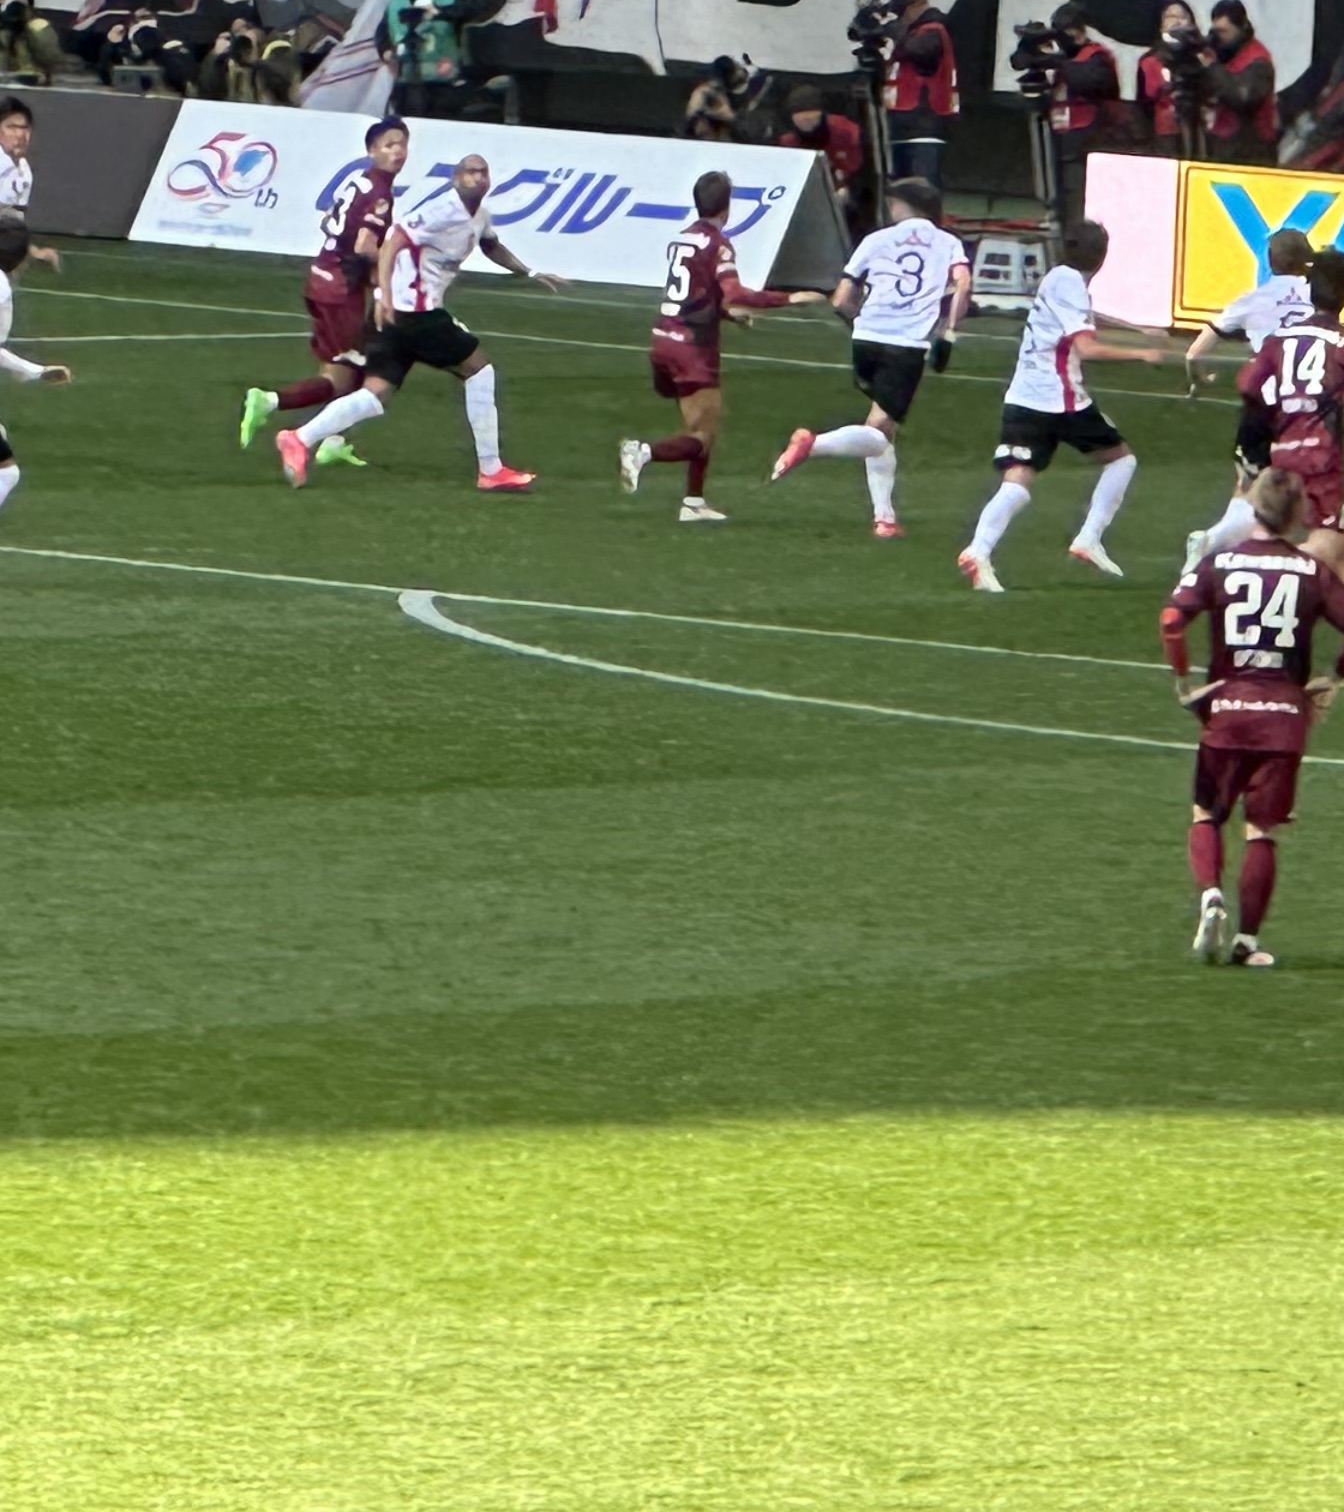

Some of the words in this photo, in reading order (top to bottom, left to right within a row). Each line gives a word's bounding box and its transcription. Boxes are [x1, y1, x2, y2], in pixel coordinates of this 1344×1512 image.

[894, 250, 926, 298] 3
[1278, 337, 1327, 396] 14
[1223, 569, 1301, 649] 24
